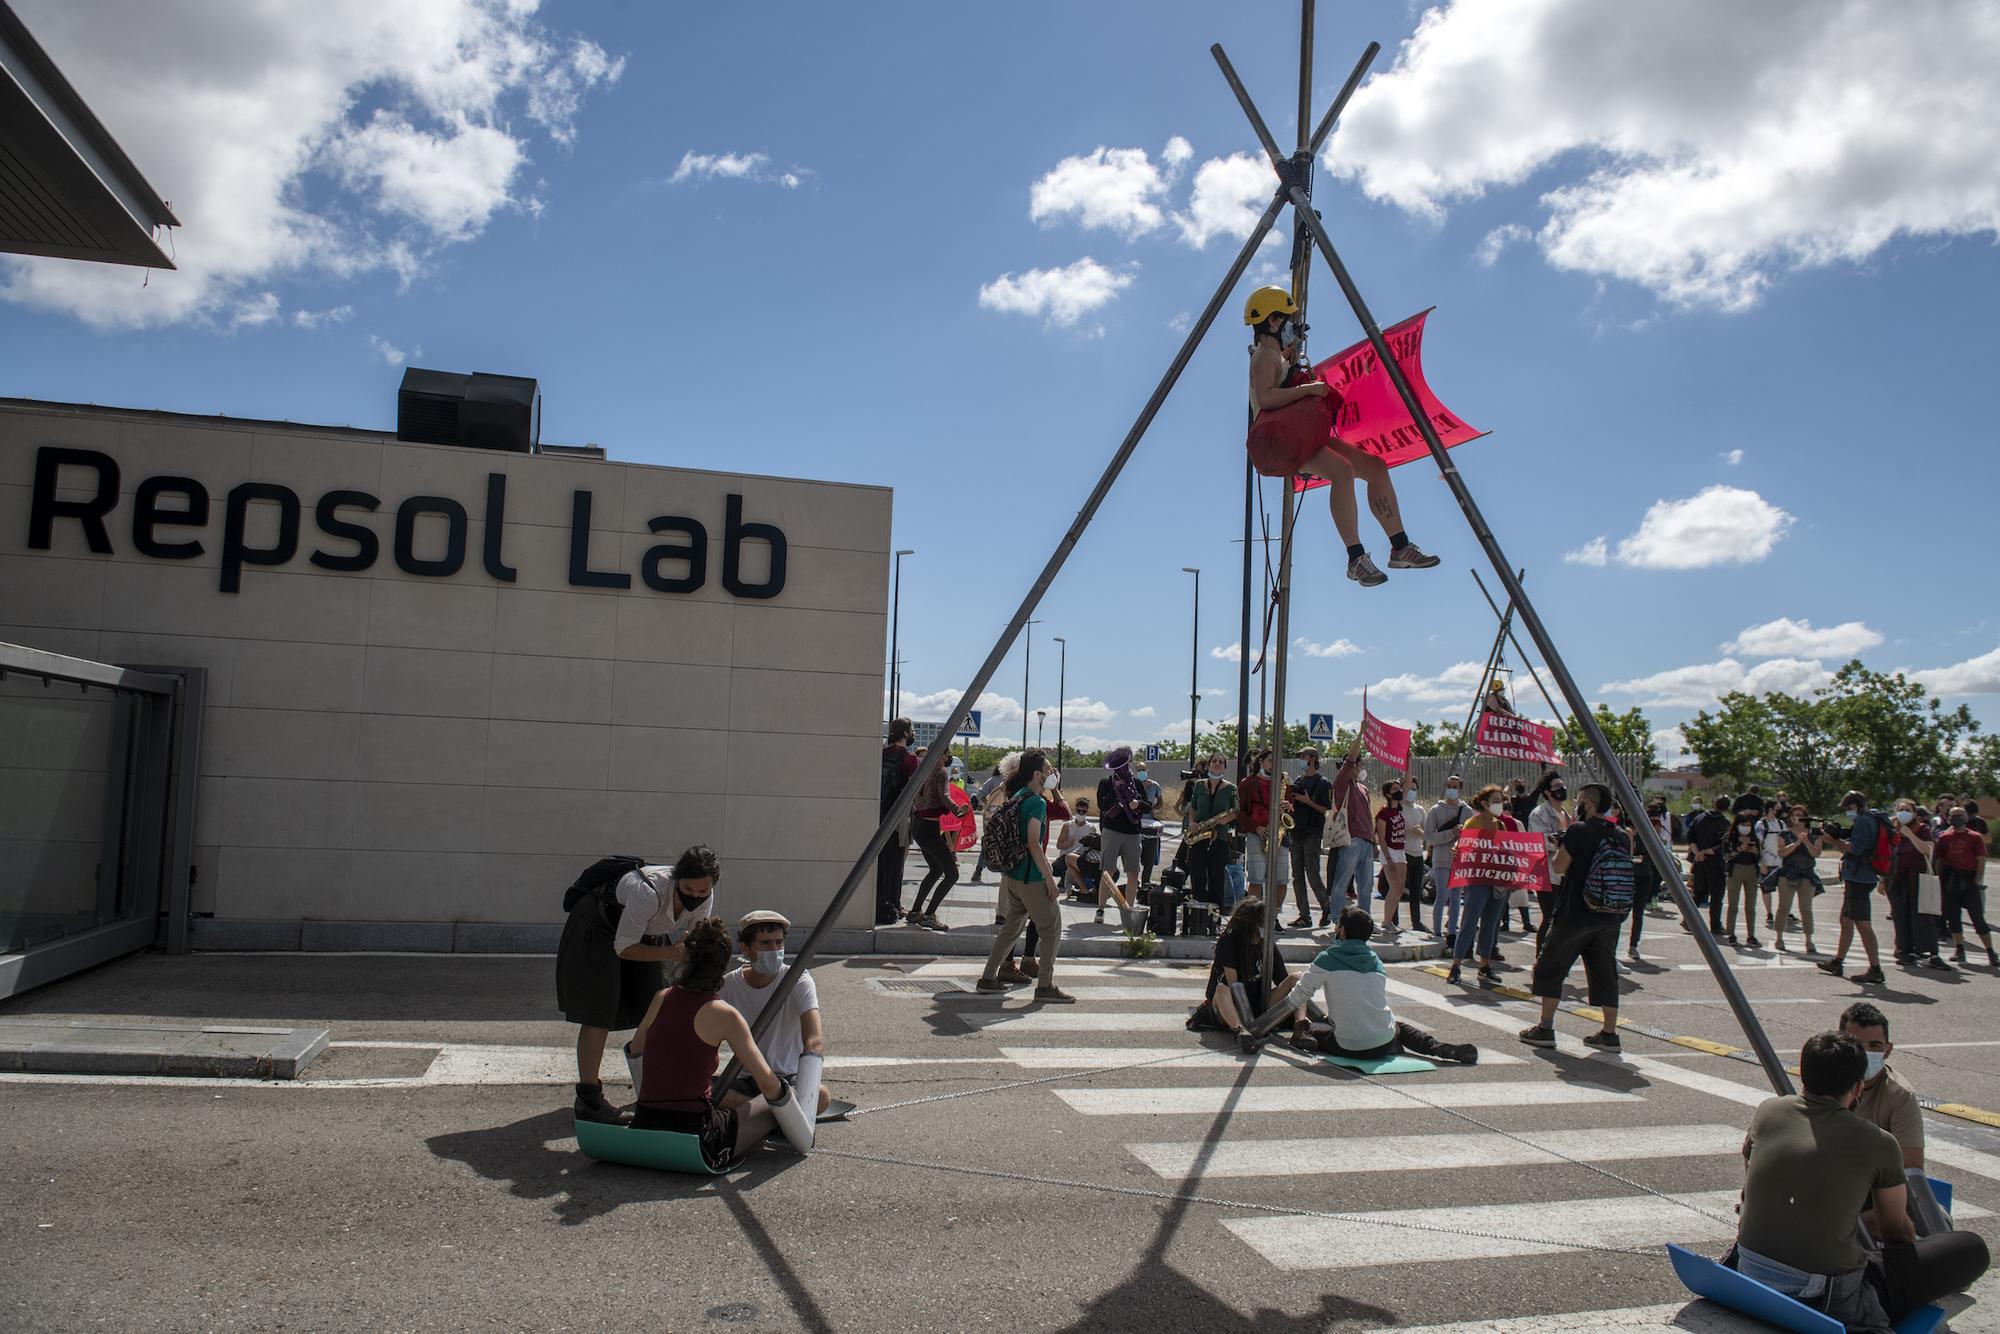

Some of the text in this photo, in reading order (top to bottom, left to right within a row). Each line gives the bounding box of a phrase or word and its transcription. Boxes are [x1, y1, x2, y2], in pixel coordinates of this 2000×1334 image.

[28, 446, 788, 600] Repsol Lab
[1149, 747, 1156, 760] P
[1460, 853, 1530, 868] EN FALSAS
[1454, 868, 1537, 884] SOLUCIONES
